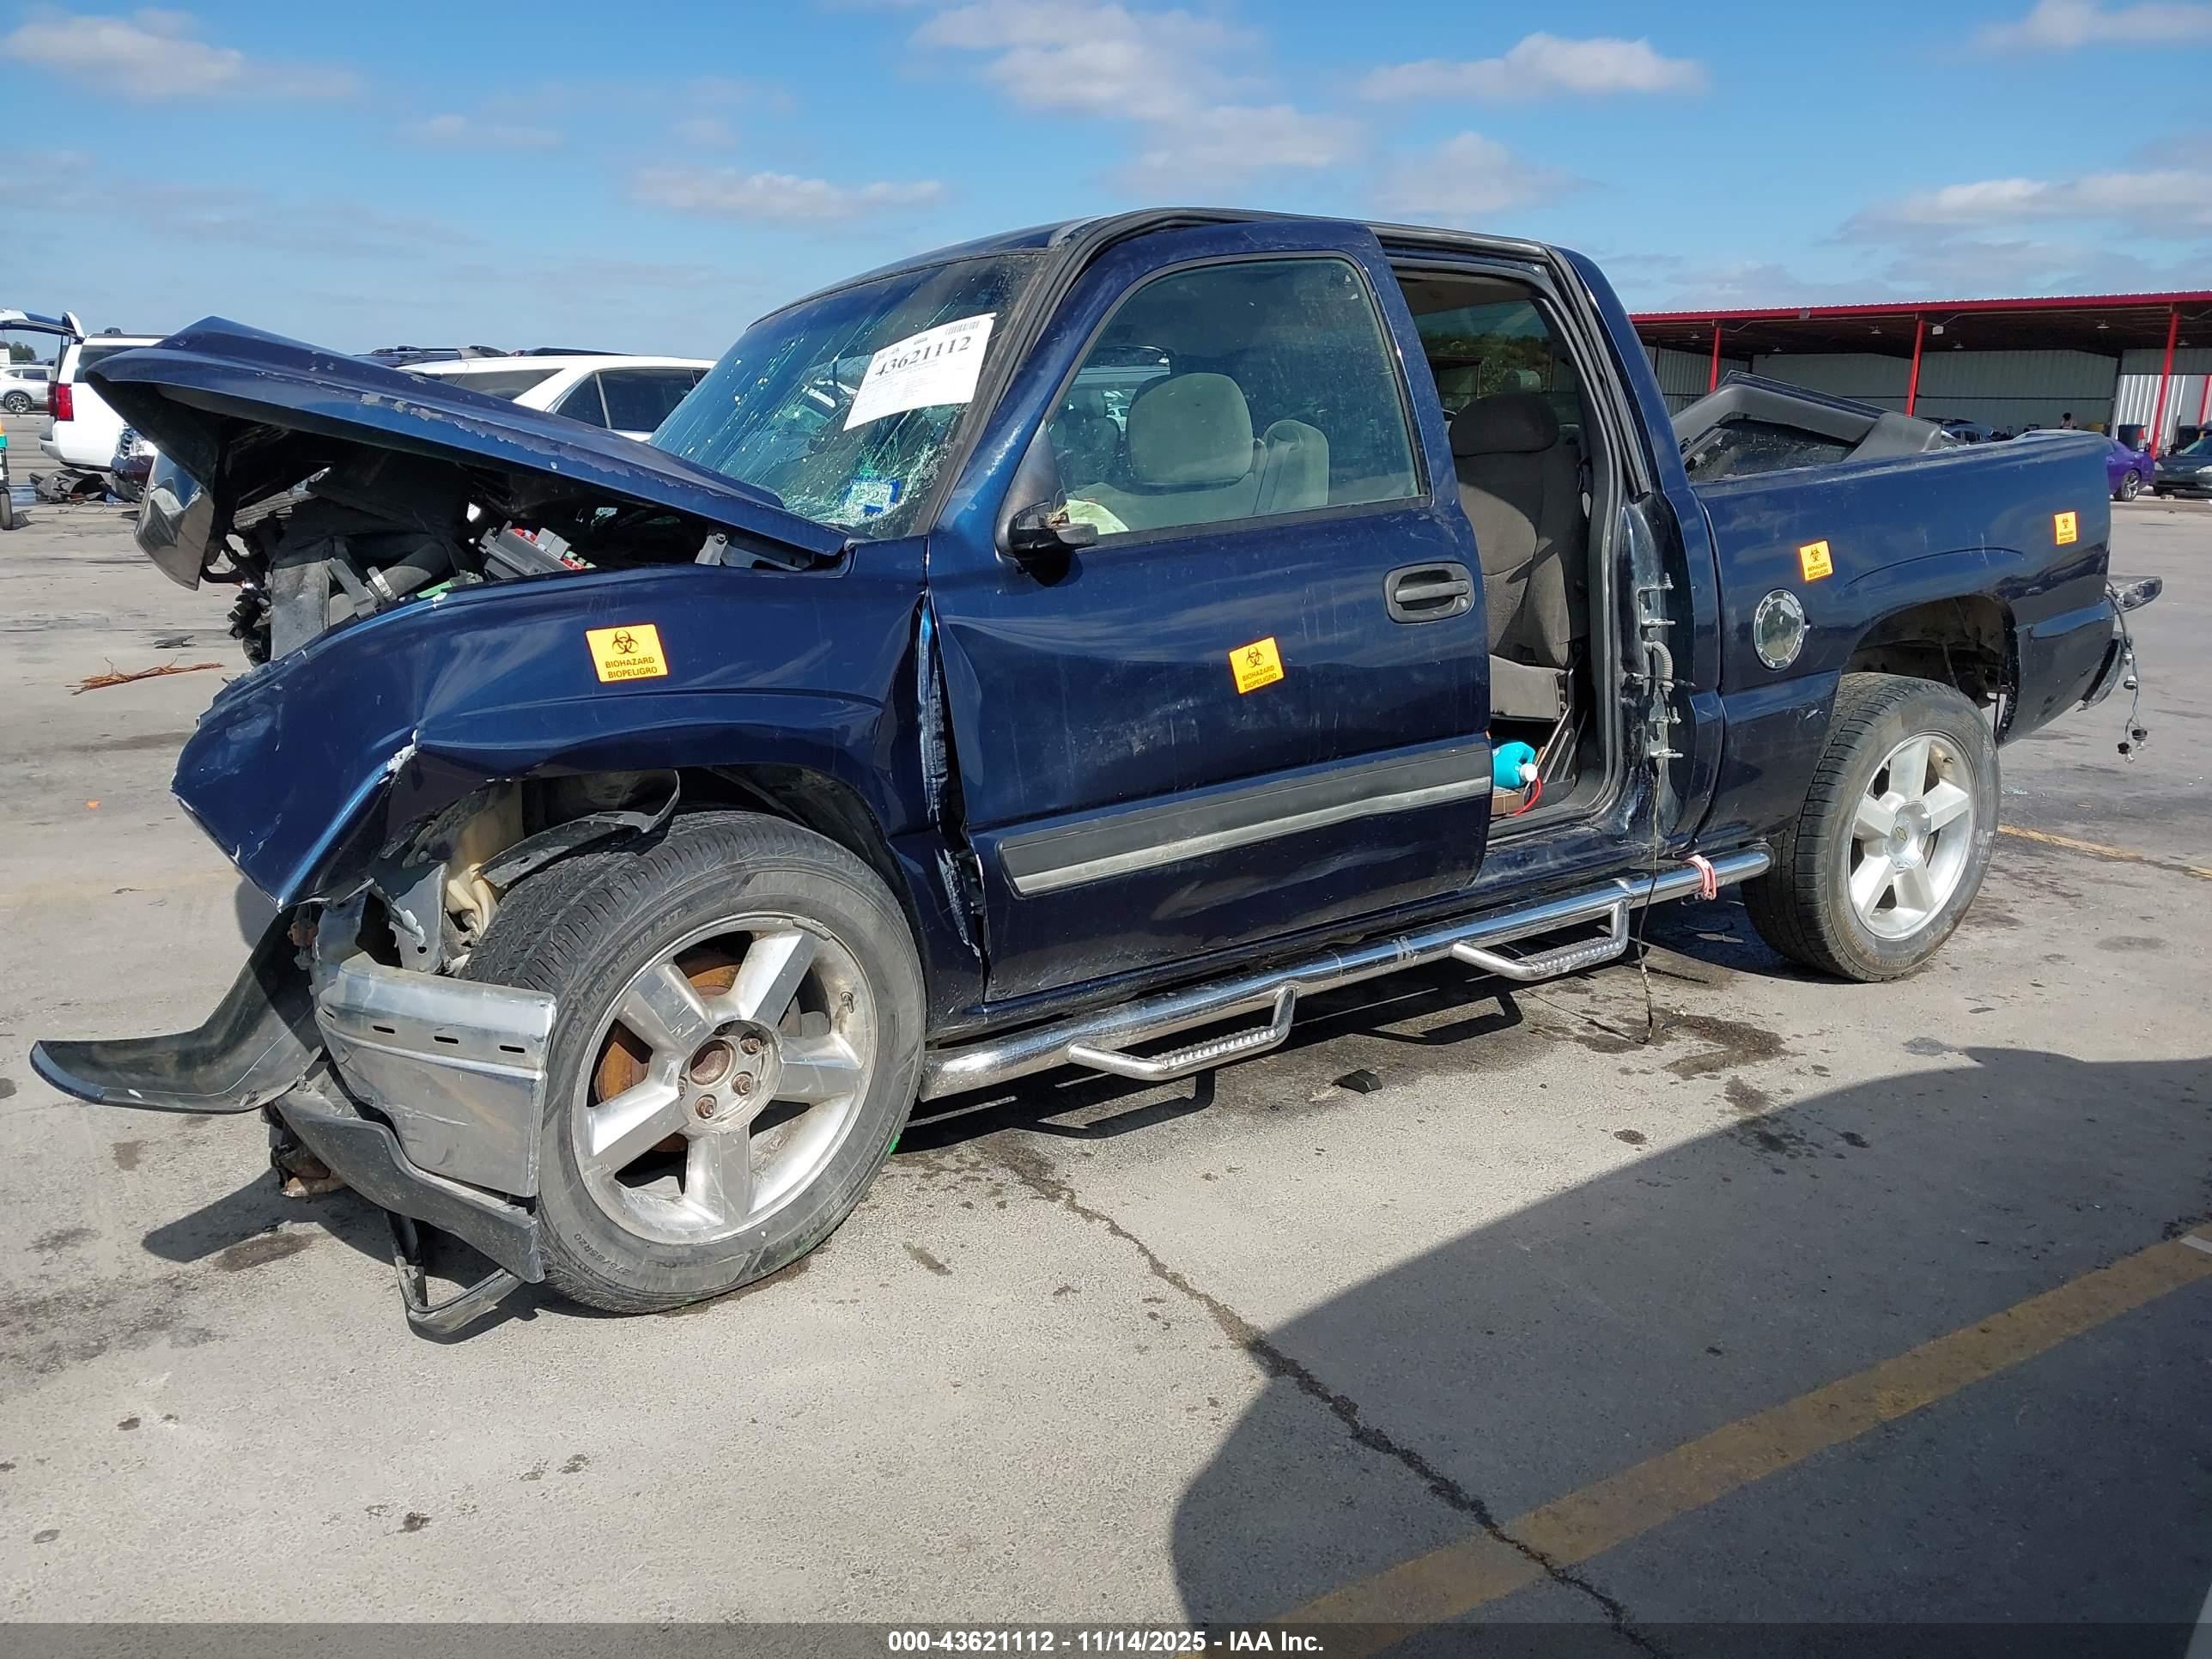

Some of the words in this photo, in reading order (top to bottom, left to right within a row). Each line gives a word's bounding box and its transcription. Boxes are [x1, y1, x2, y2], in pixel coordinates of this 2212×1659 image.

[875, 335, 972, 377] 43621112
[605, 656, 655, 669] BIOHAZARD
[607, 666, 658, 679] BIOPELIGRO
[1242, 665, 1275, 682] BIOHAZARD
[1243, 672, 1277, 690] BIOPELIGRO
